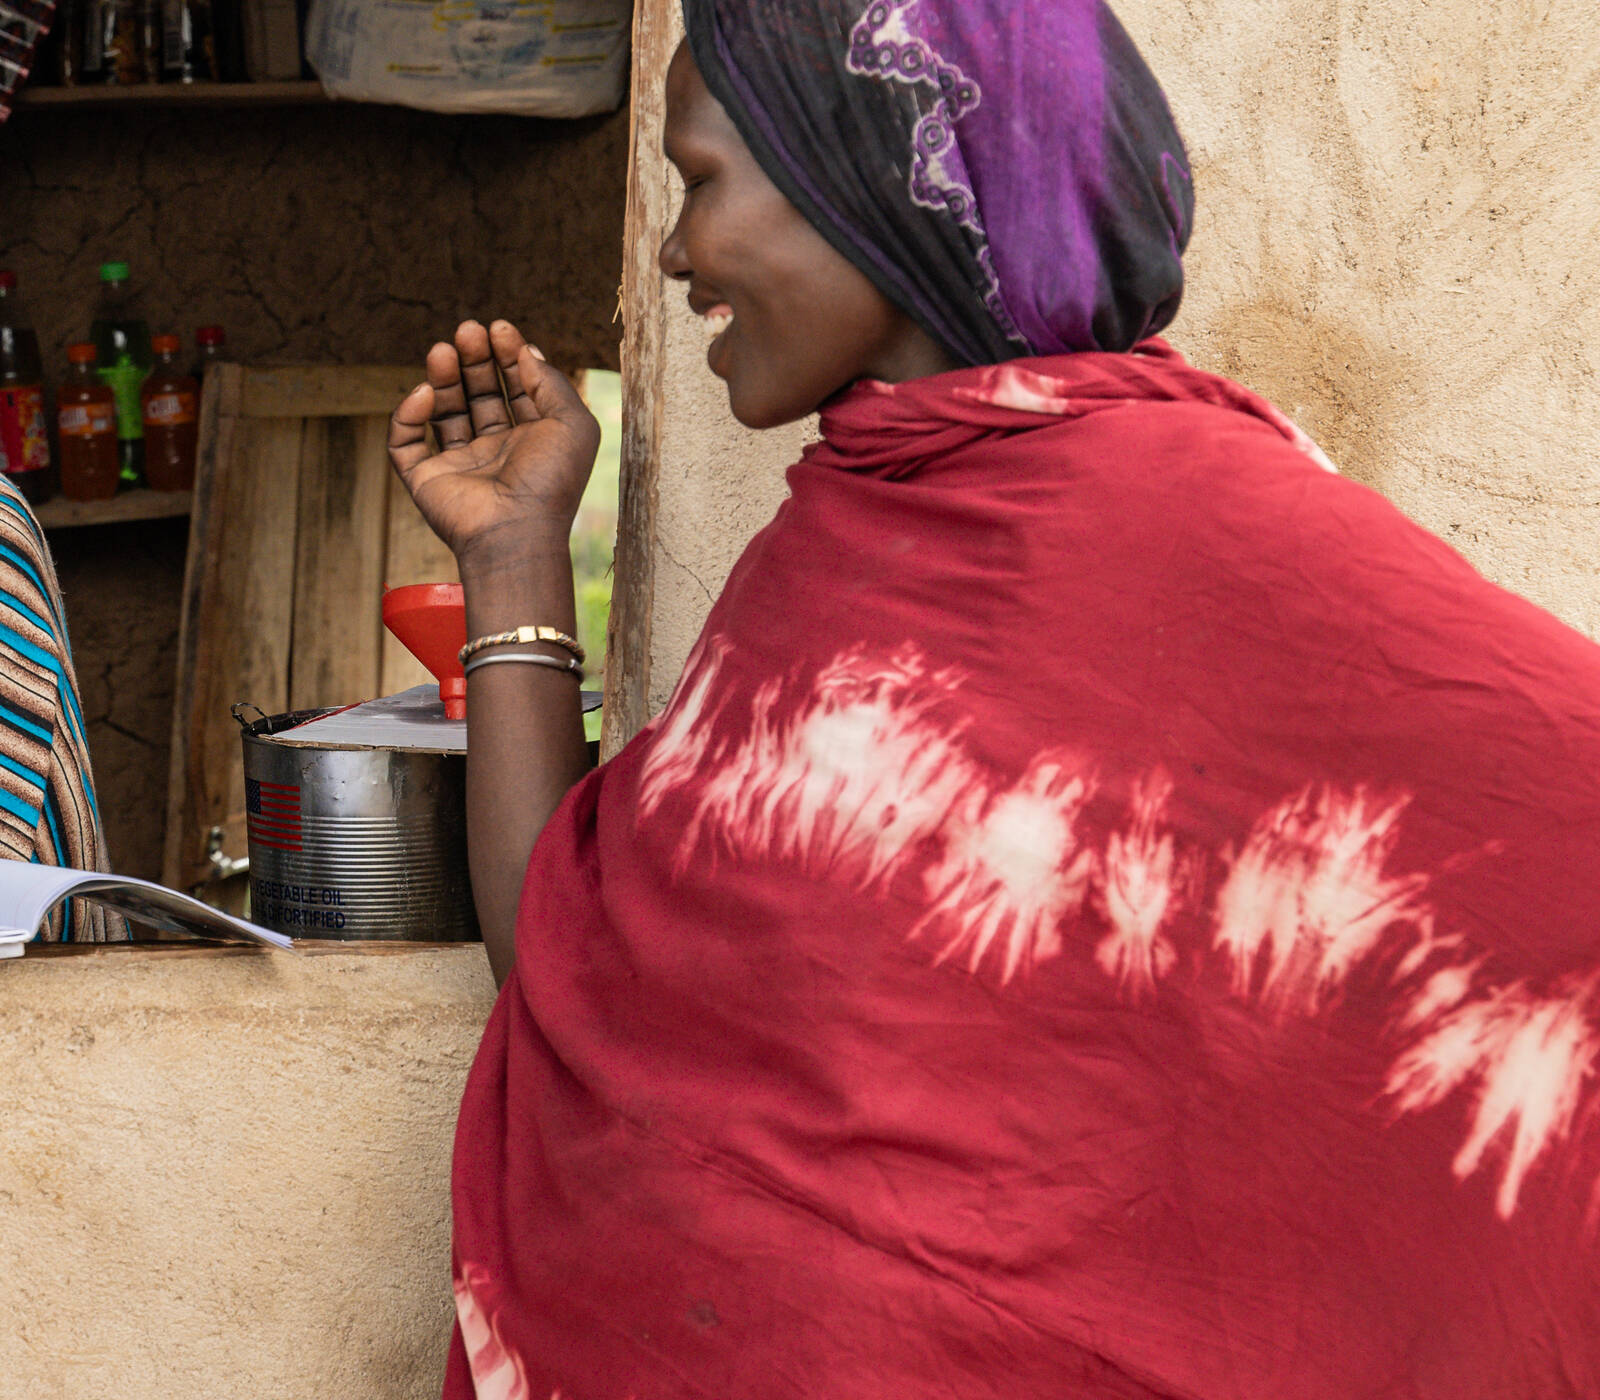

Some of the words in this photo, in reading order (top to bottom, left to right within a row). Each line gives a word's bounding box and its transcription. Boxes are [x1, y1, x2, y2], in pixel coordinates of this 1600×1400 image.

[256, 880, 318, 905] VEGETABLE
[321, 888, 346, 906] OIL
[278, 906, 346, 929] FORTIFIED
